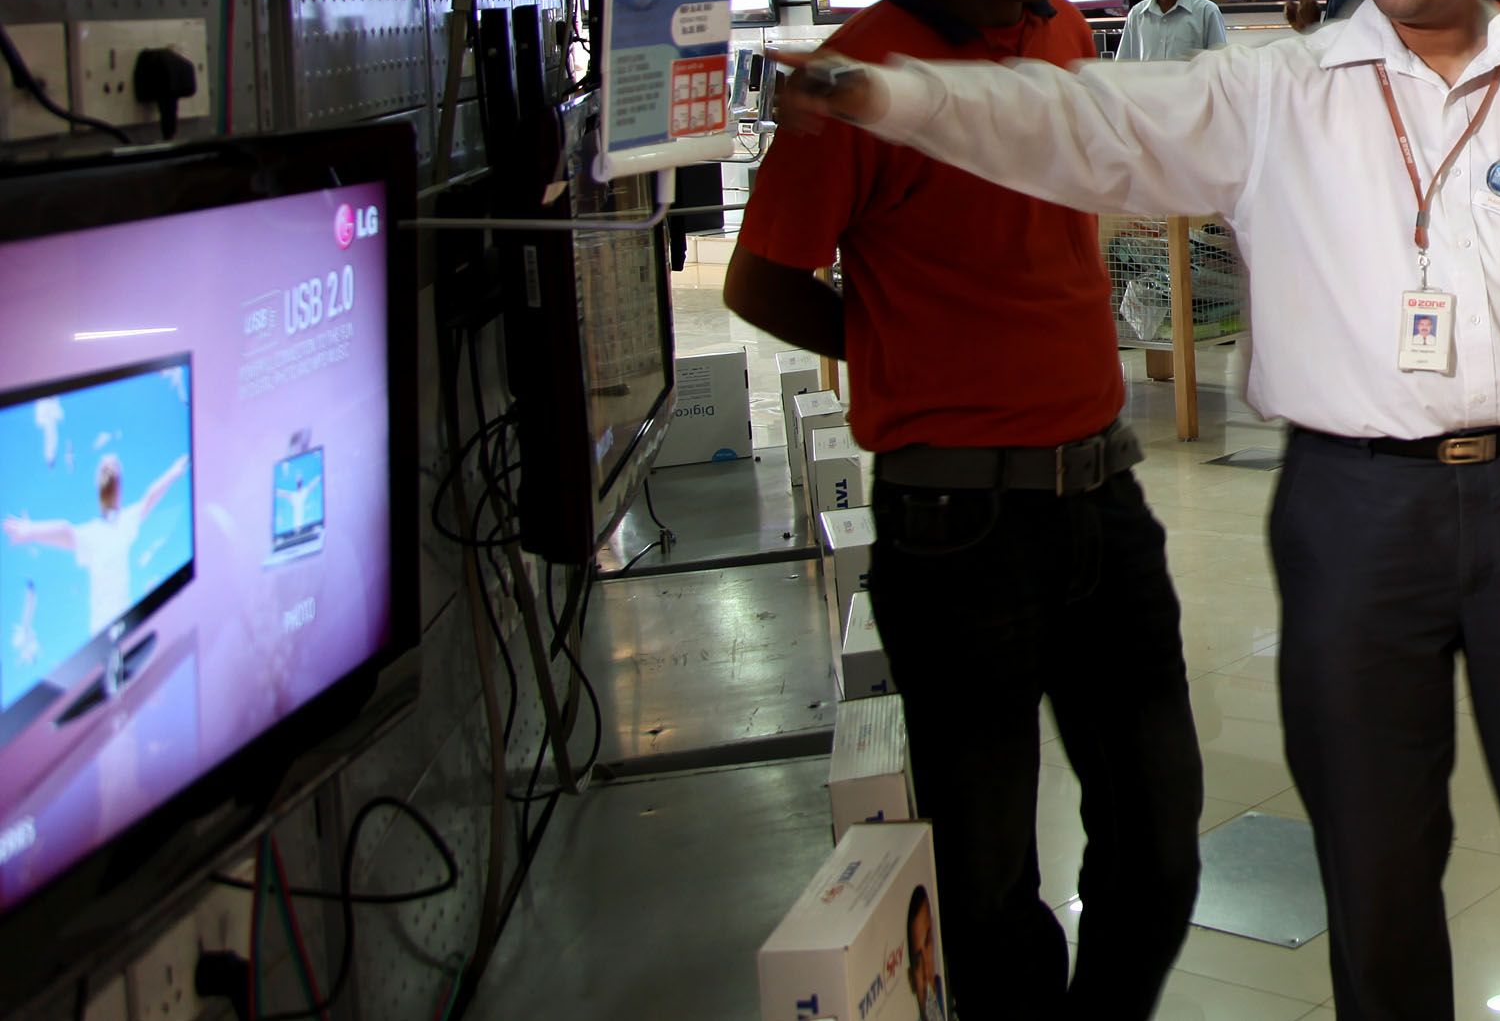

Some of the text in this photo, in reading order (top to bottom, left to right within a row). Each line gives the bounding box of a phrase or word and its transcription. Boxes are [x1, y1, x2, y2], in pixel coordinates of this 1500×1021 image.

[357, 205, 379, 238] LG
[284, 264, 354, 335] USB 2.0
[675, 404, 715, 418] Digico
[835, 478, 848, 509] TAT
